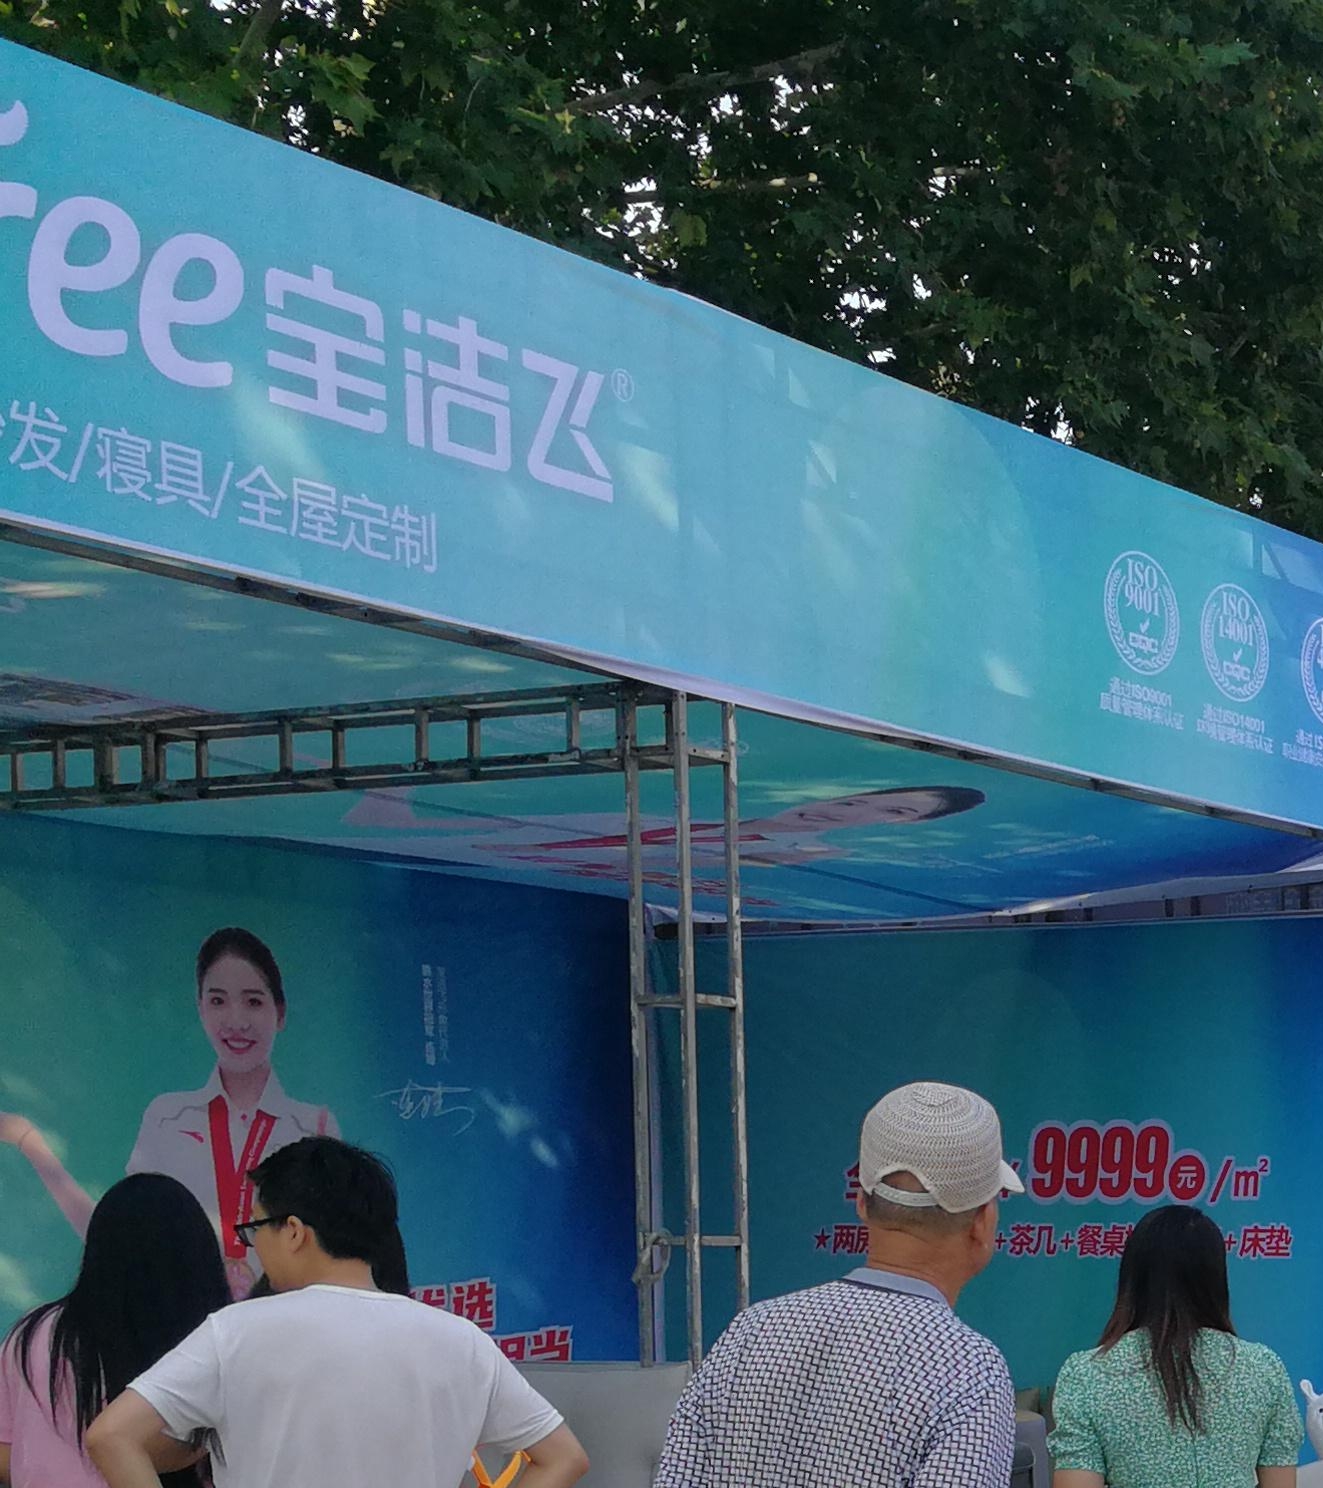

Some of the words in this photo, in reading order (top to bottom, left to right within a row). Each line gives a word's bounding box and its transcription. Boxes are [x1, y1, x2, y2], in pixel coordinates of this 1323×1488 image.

[265, 264, 613, 503] 宝洁飞
[0, 400, 438, 574] 发/寝具/全屋定制
[1126, 558, 1158, 592] ISO
[1124, 583, 1160, 617] 9001
[1221, 591, 1250, 622] ISO
[1218, 615, 1254, 647] 14001
